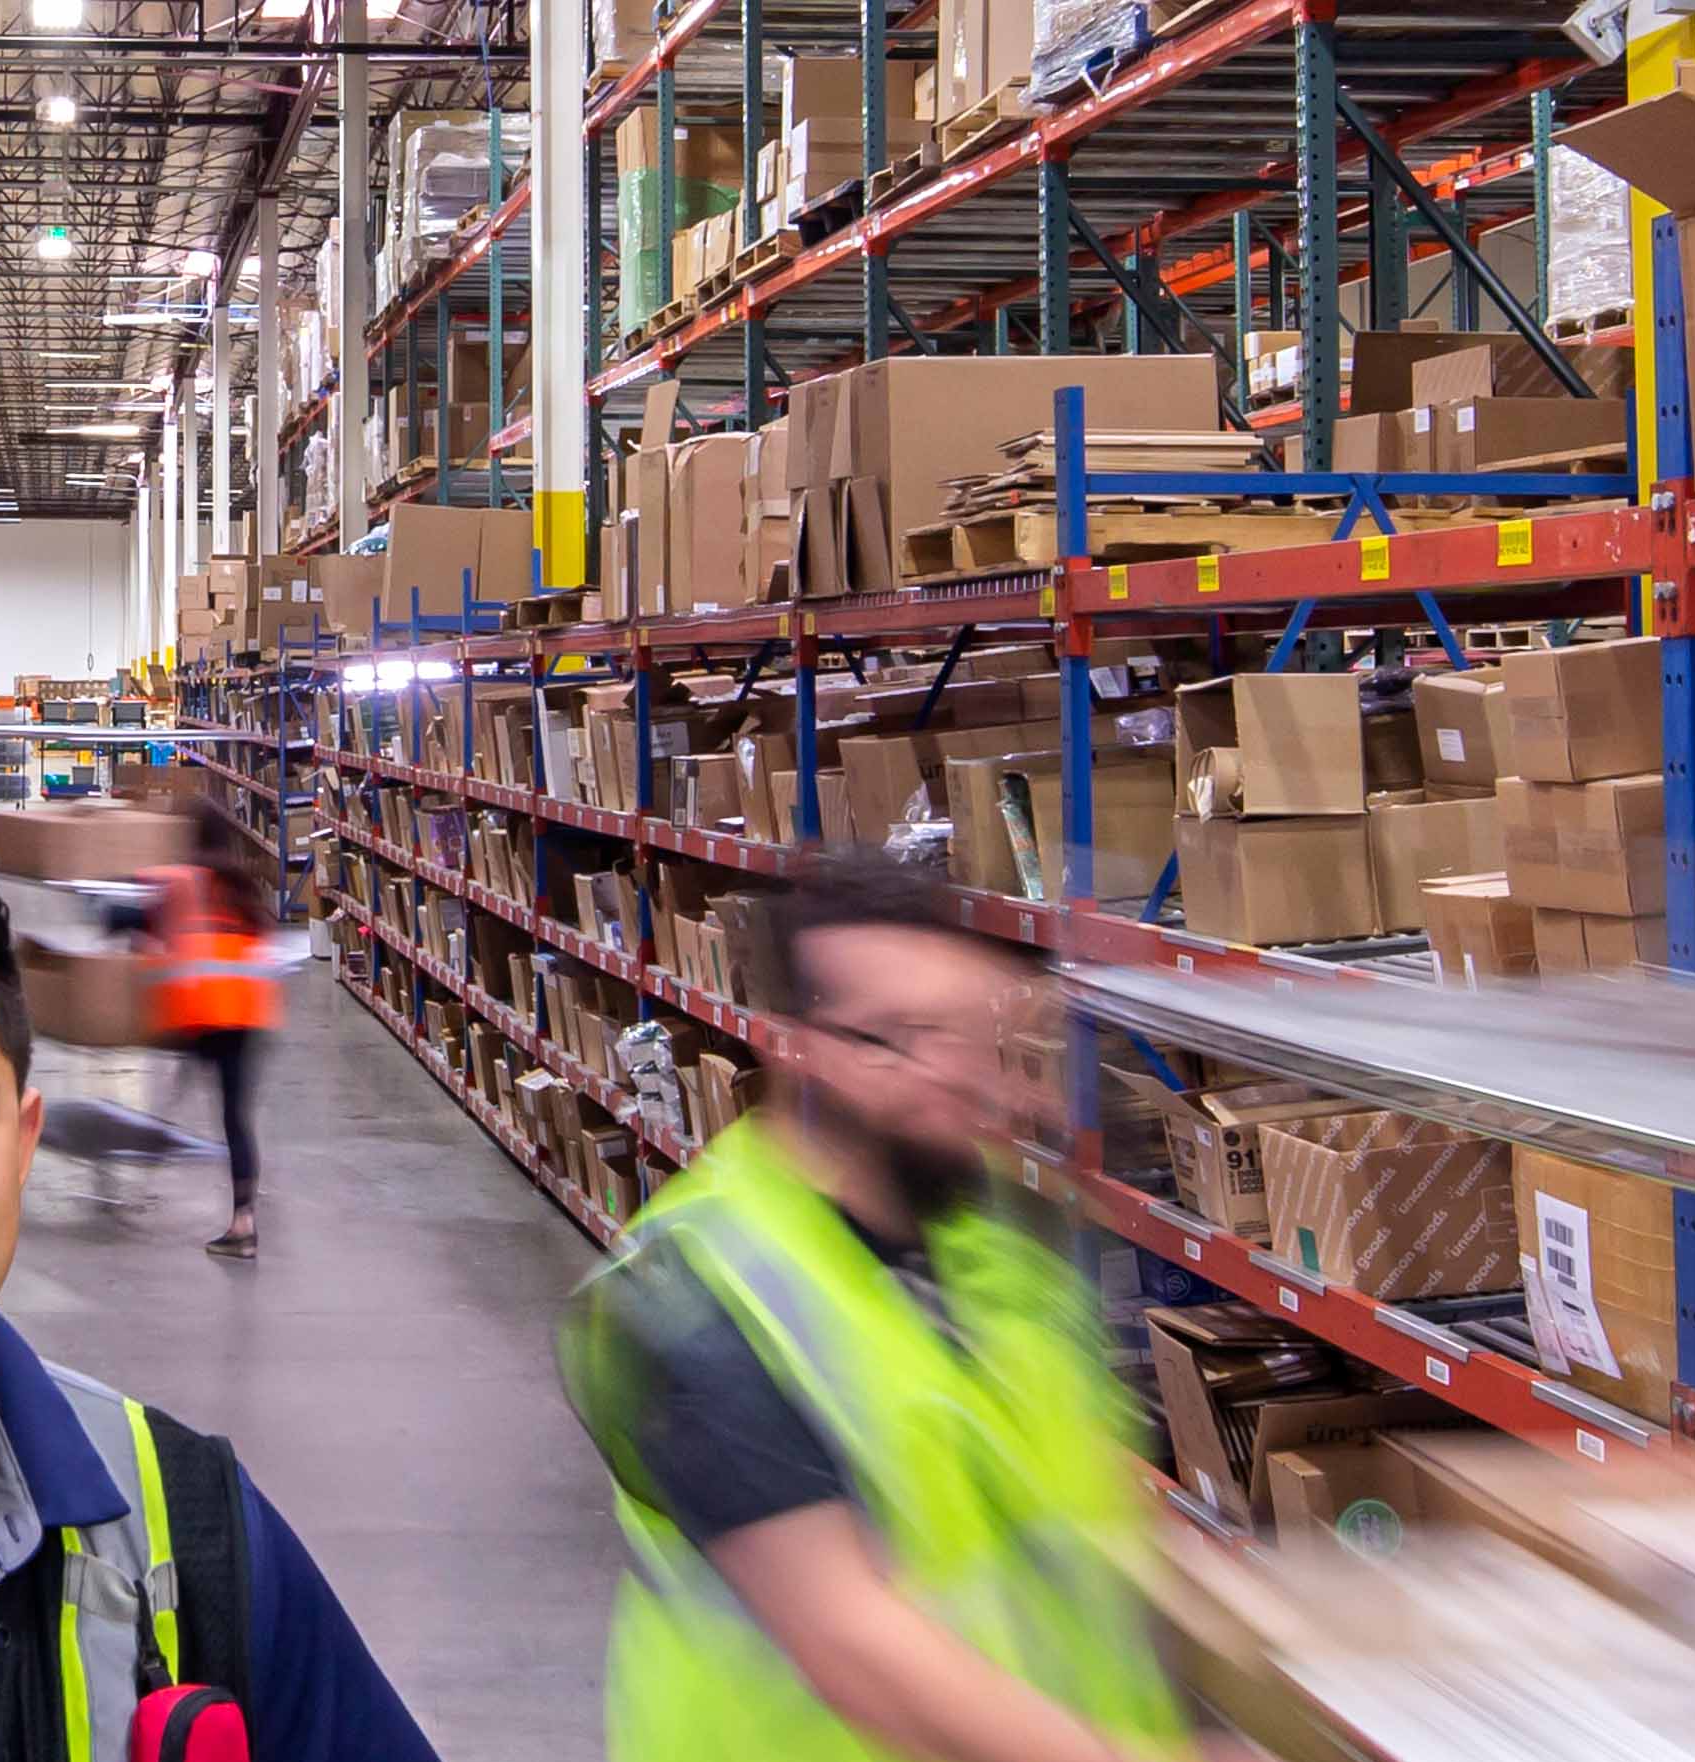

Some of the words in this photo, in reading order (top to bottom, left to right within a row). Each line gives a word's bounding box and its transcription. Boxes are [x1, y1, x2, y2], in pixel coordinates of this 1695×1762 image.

[1362, 1166, 1396, 1212] goods
[1398, 1140, 1460, 1215] uncommon
[1412, 1208, 1449, 1254] goods
